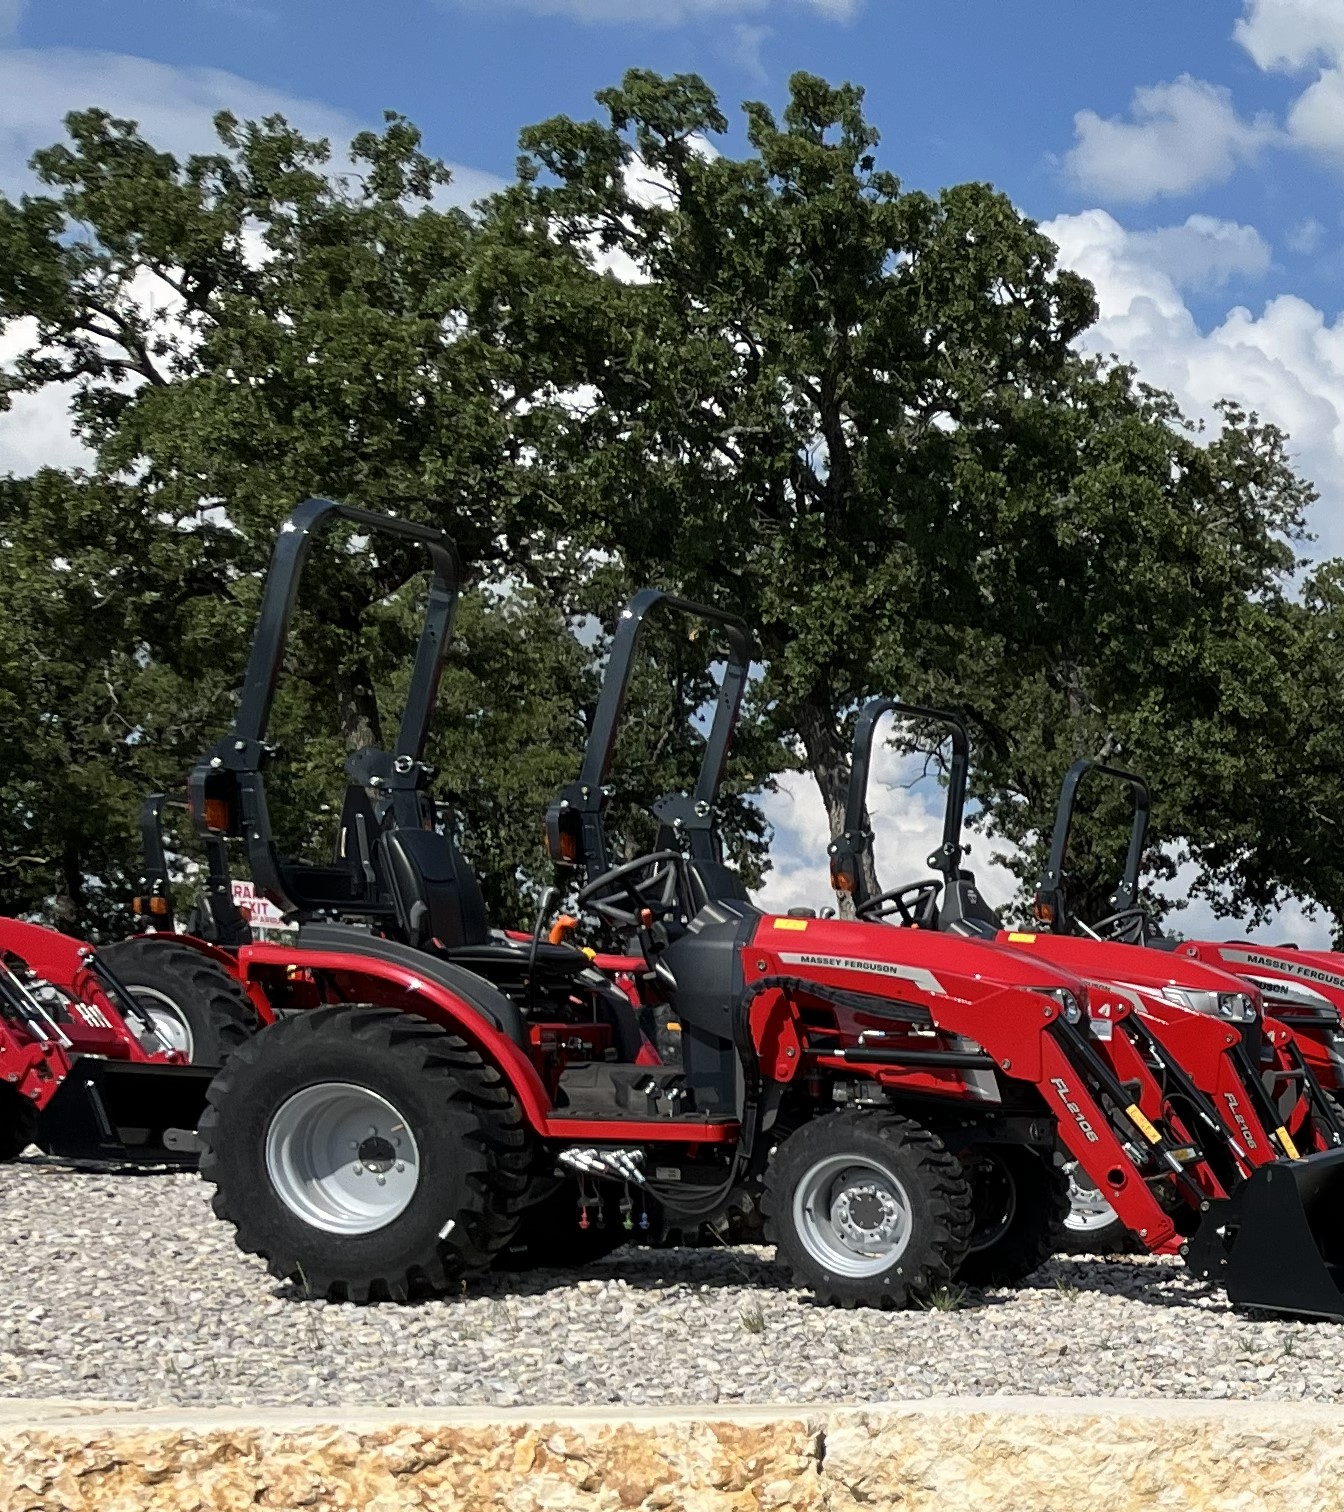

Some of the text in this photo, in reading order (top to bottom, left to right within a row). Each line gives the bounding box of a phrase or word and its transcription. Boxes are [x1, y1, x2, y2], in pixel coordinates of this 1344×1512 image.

[800, 955, 898, 974] MASSEY FERGUSON
[1247, 954, 1295, 972] MASSEY
